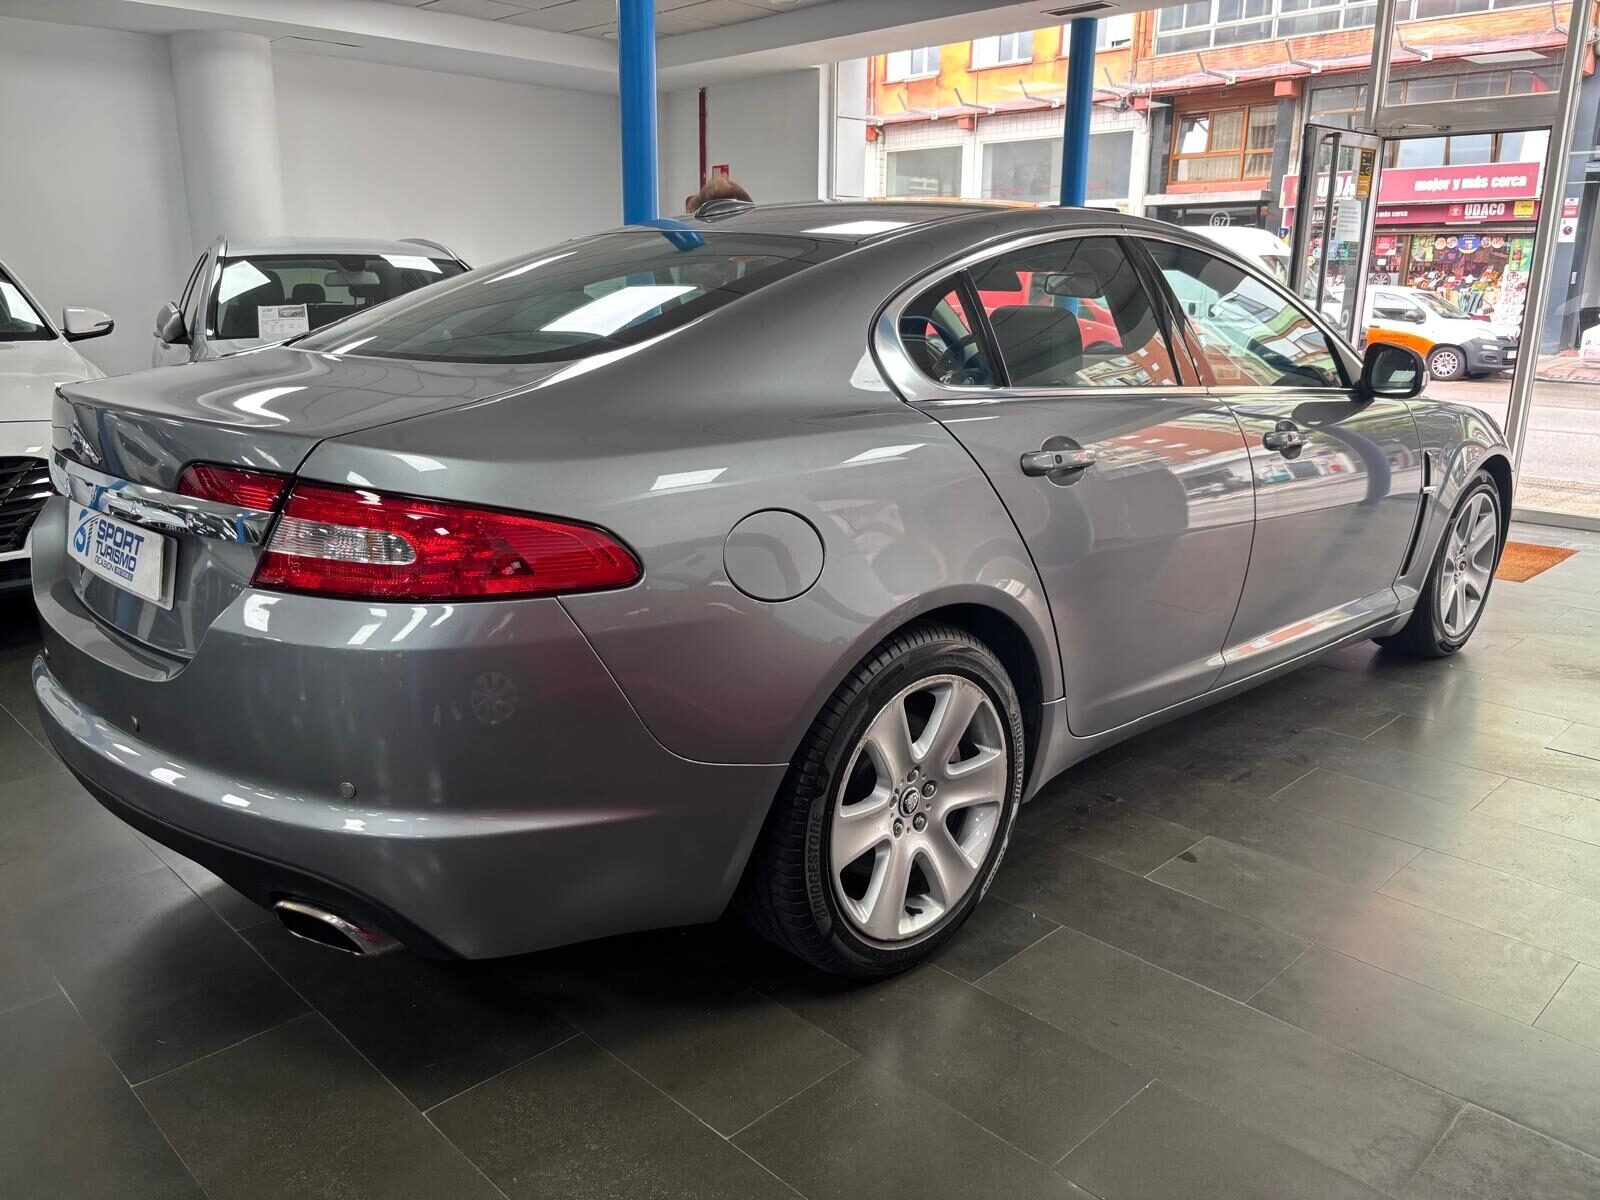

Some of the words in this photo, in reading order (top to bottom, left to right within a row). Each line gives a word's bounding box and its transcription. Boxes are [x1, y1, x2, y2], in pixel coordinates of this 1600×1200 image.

[1414, 178, 1450, 191] mejor
[1452, 178, 1461, 190] y
[1461, 176, 1489, 188] más
[1491, 175, 1528, 188] cerca
[1213, 216, 1226, 226] 87
[1464, 202, 1505, 216] UDACO
[97, 519, 145, 556] SPORT
[95, 540, 137, 572] TURISMO
[807, 811, 828, 921] BRIDGESTONE
